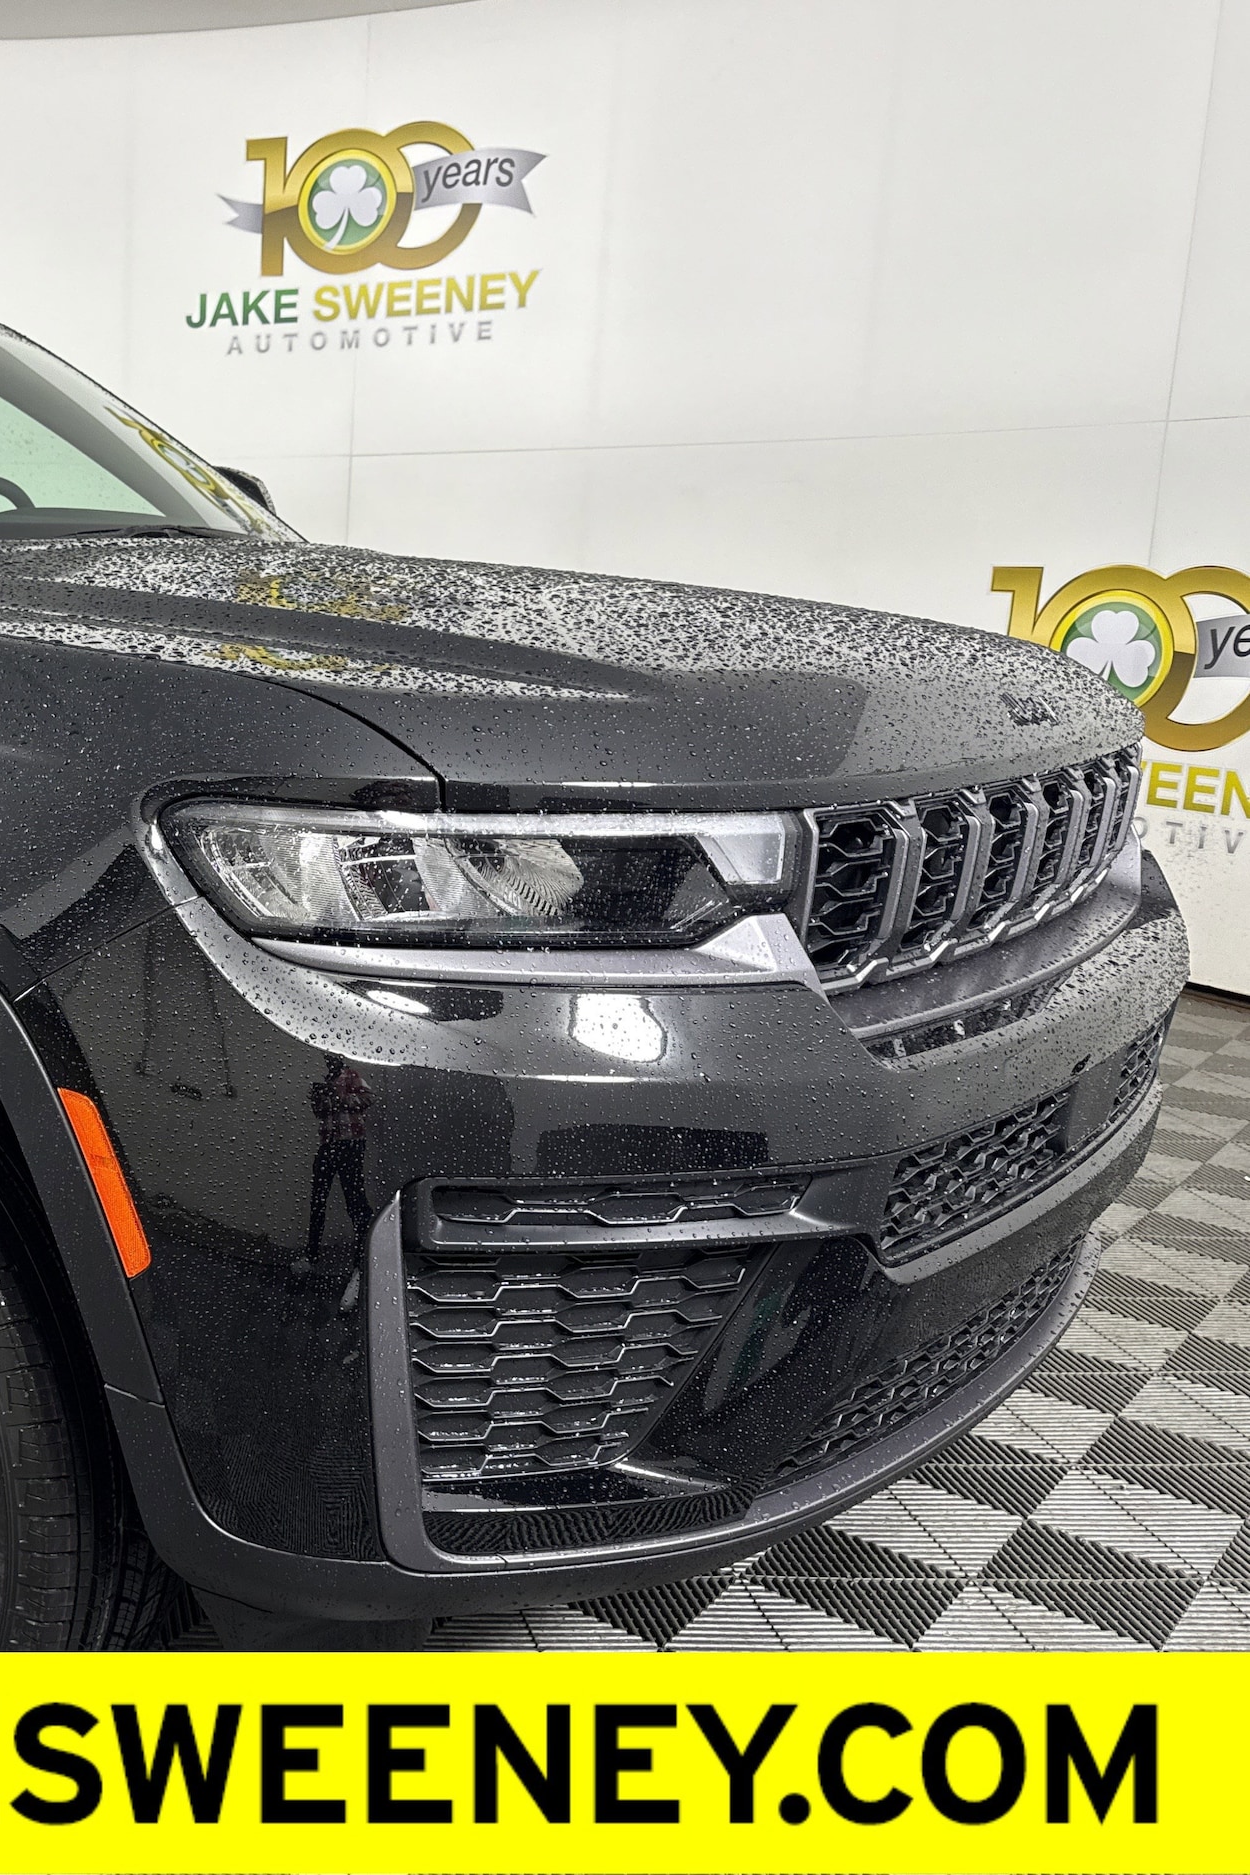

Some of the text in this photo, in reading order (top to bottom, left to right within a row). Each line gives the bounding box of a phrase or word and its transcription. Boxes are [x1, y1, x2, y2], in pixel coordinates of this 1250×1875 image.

[422, 156, 517, 203] years
[186, 269, 541, 329] JAKE SWEENEY
[226, 320, 494, 356] AUTOMOTIVE
